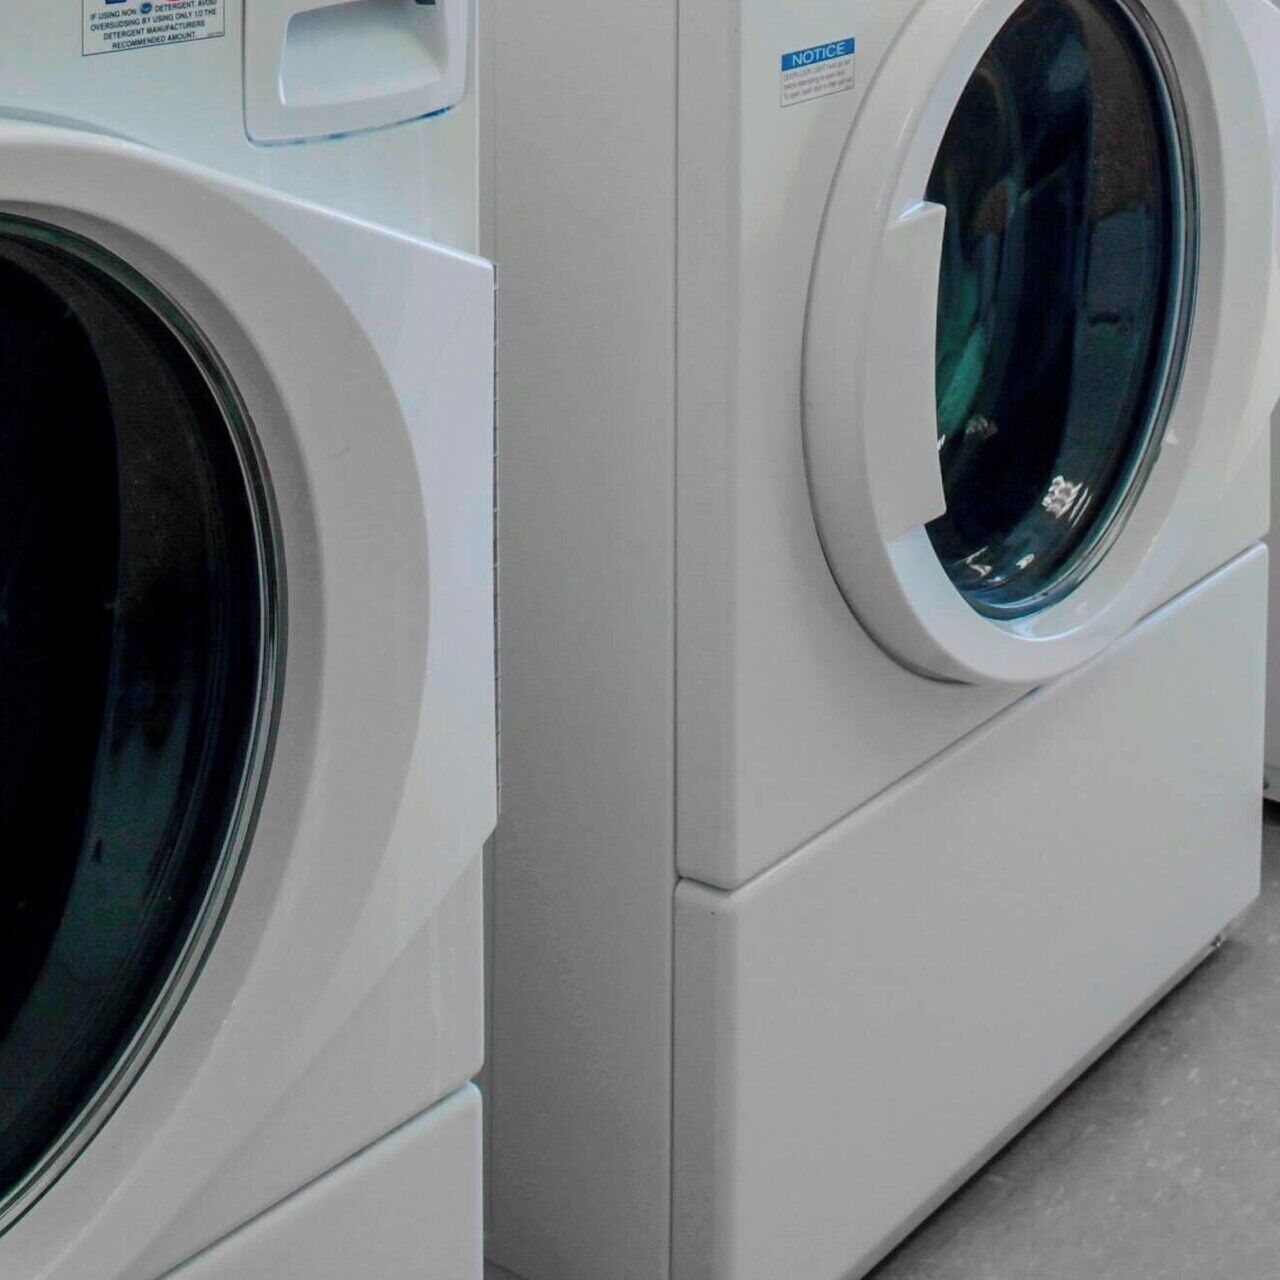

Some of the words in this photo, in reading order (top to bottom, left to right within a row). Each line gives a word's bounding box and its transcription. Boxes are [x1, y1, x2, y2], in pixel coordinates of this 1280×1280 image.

[98, 11, 120, 20] USING
[122, 9, 136, 17] NON
[175, 12, 192, 20] ONLY
[204, 8, 217, 16] THE
[103, 28, 144, 40] DETERGENT
[112, 35, 166, 49] RECOMMENDED
[792, 42, 846, 66] NOTICE
